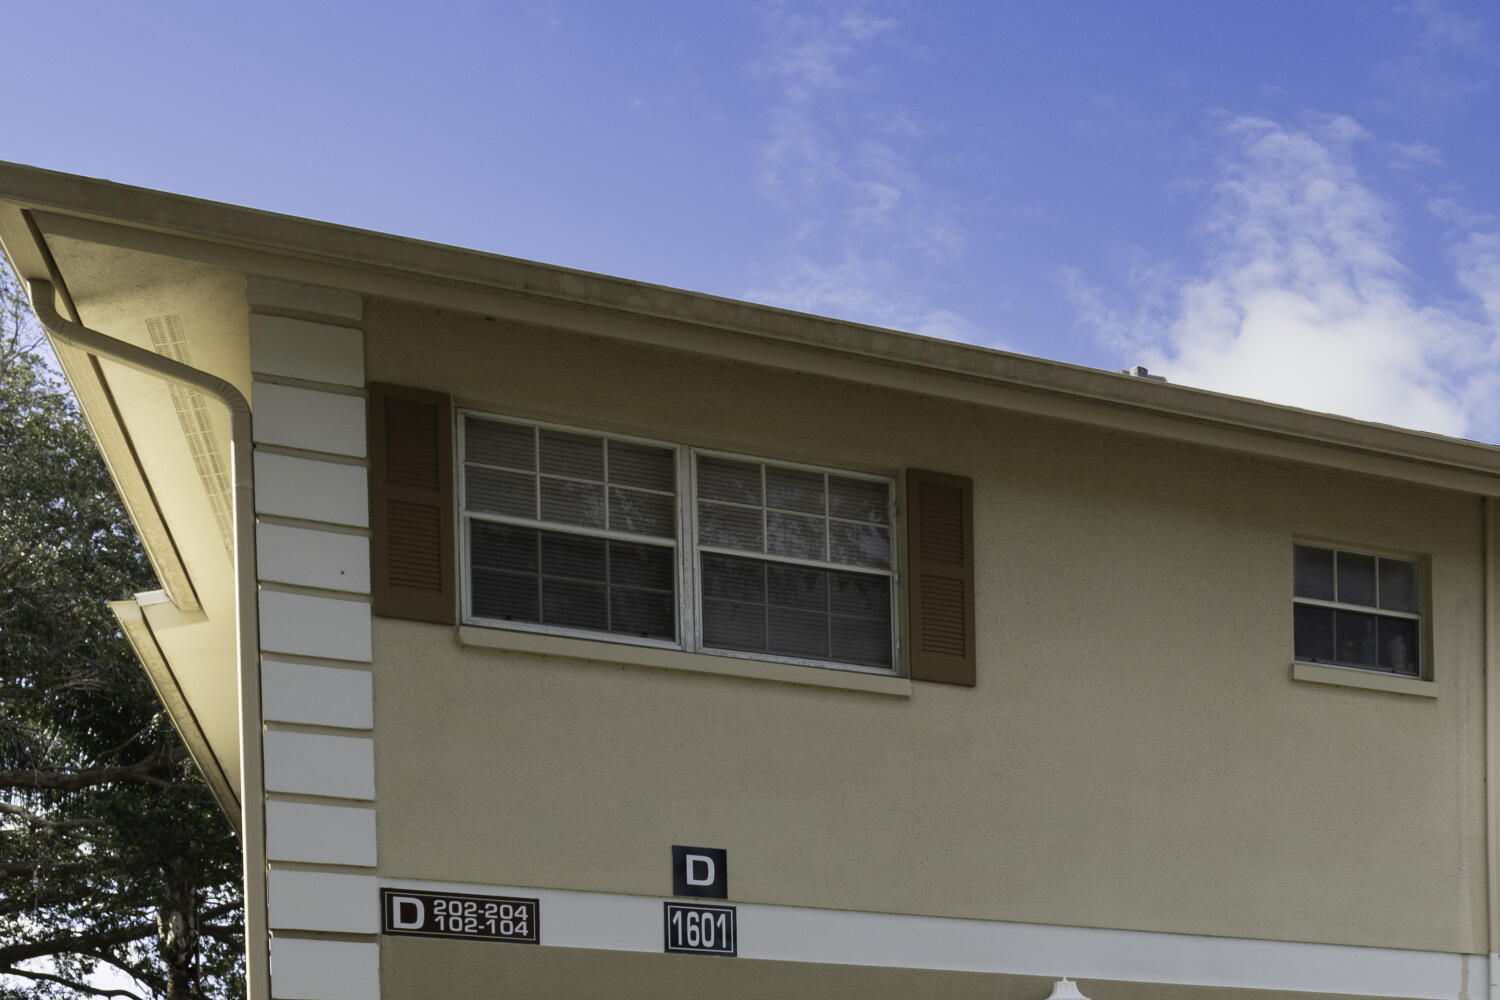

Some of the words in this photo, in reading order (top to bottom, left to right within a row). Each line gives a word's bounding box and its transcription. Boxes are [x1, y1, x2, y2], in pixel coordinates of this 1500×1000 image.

[686, 854, 715, 886] D
[392, 896, 425, 930] D
[433, 899, 529, 921] 202-204
[433, 915, 529, 937] 102-104
[672, 911, 727, 949] 1601
